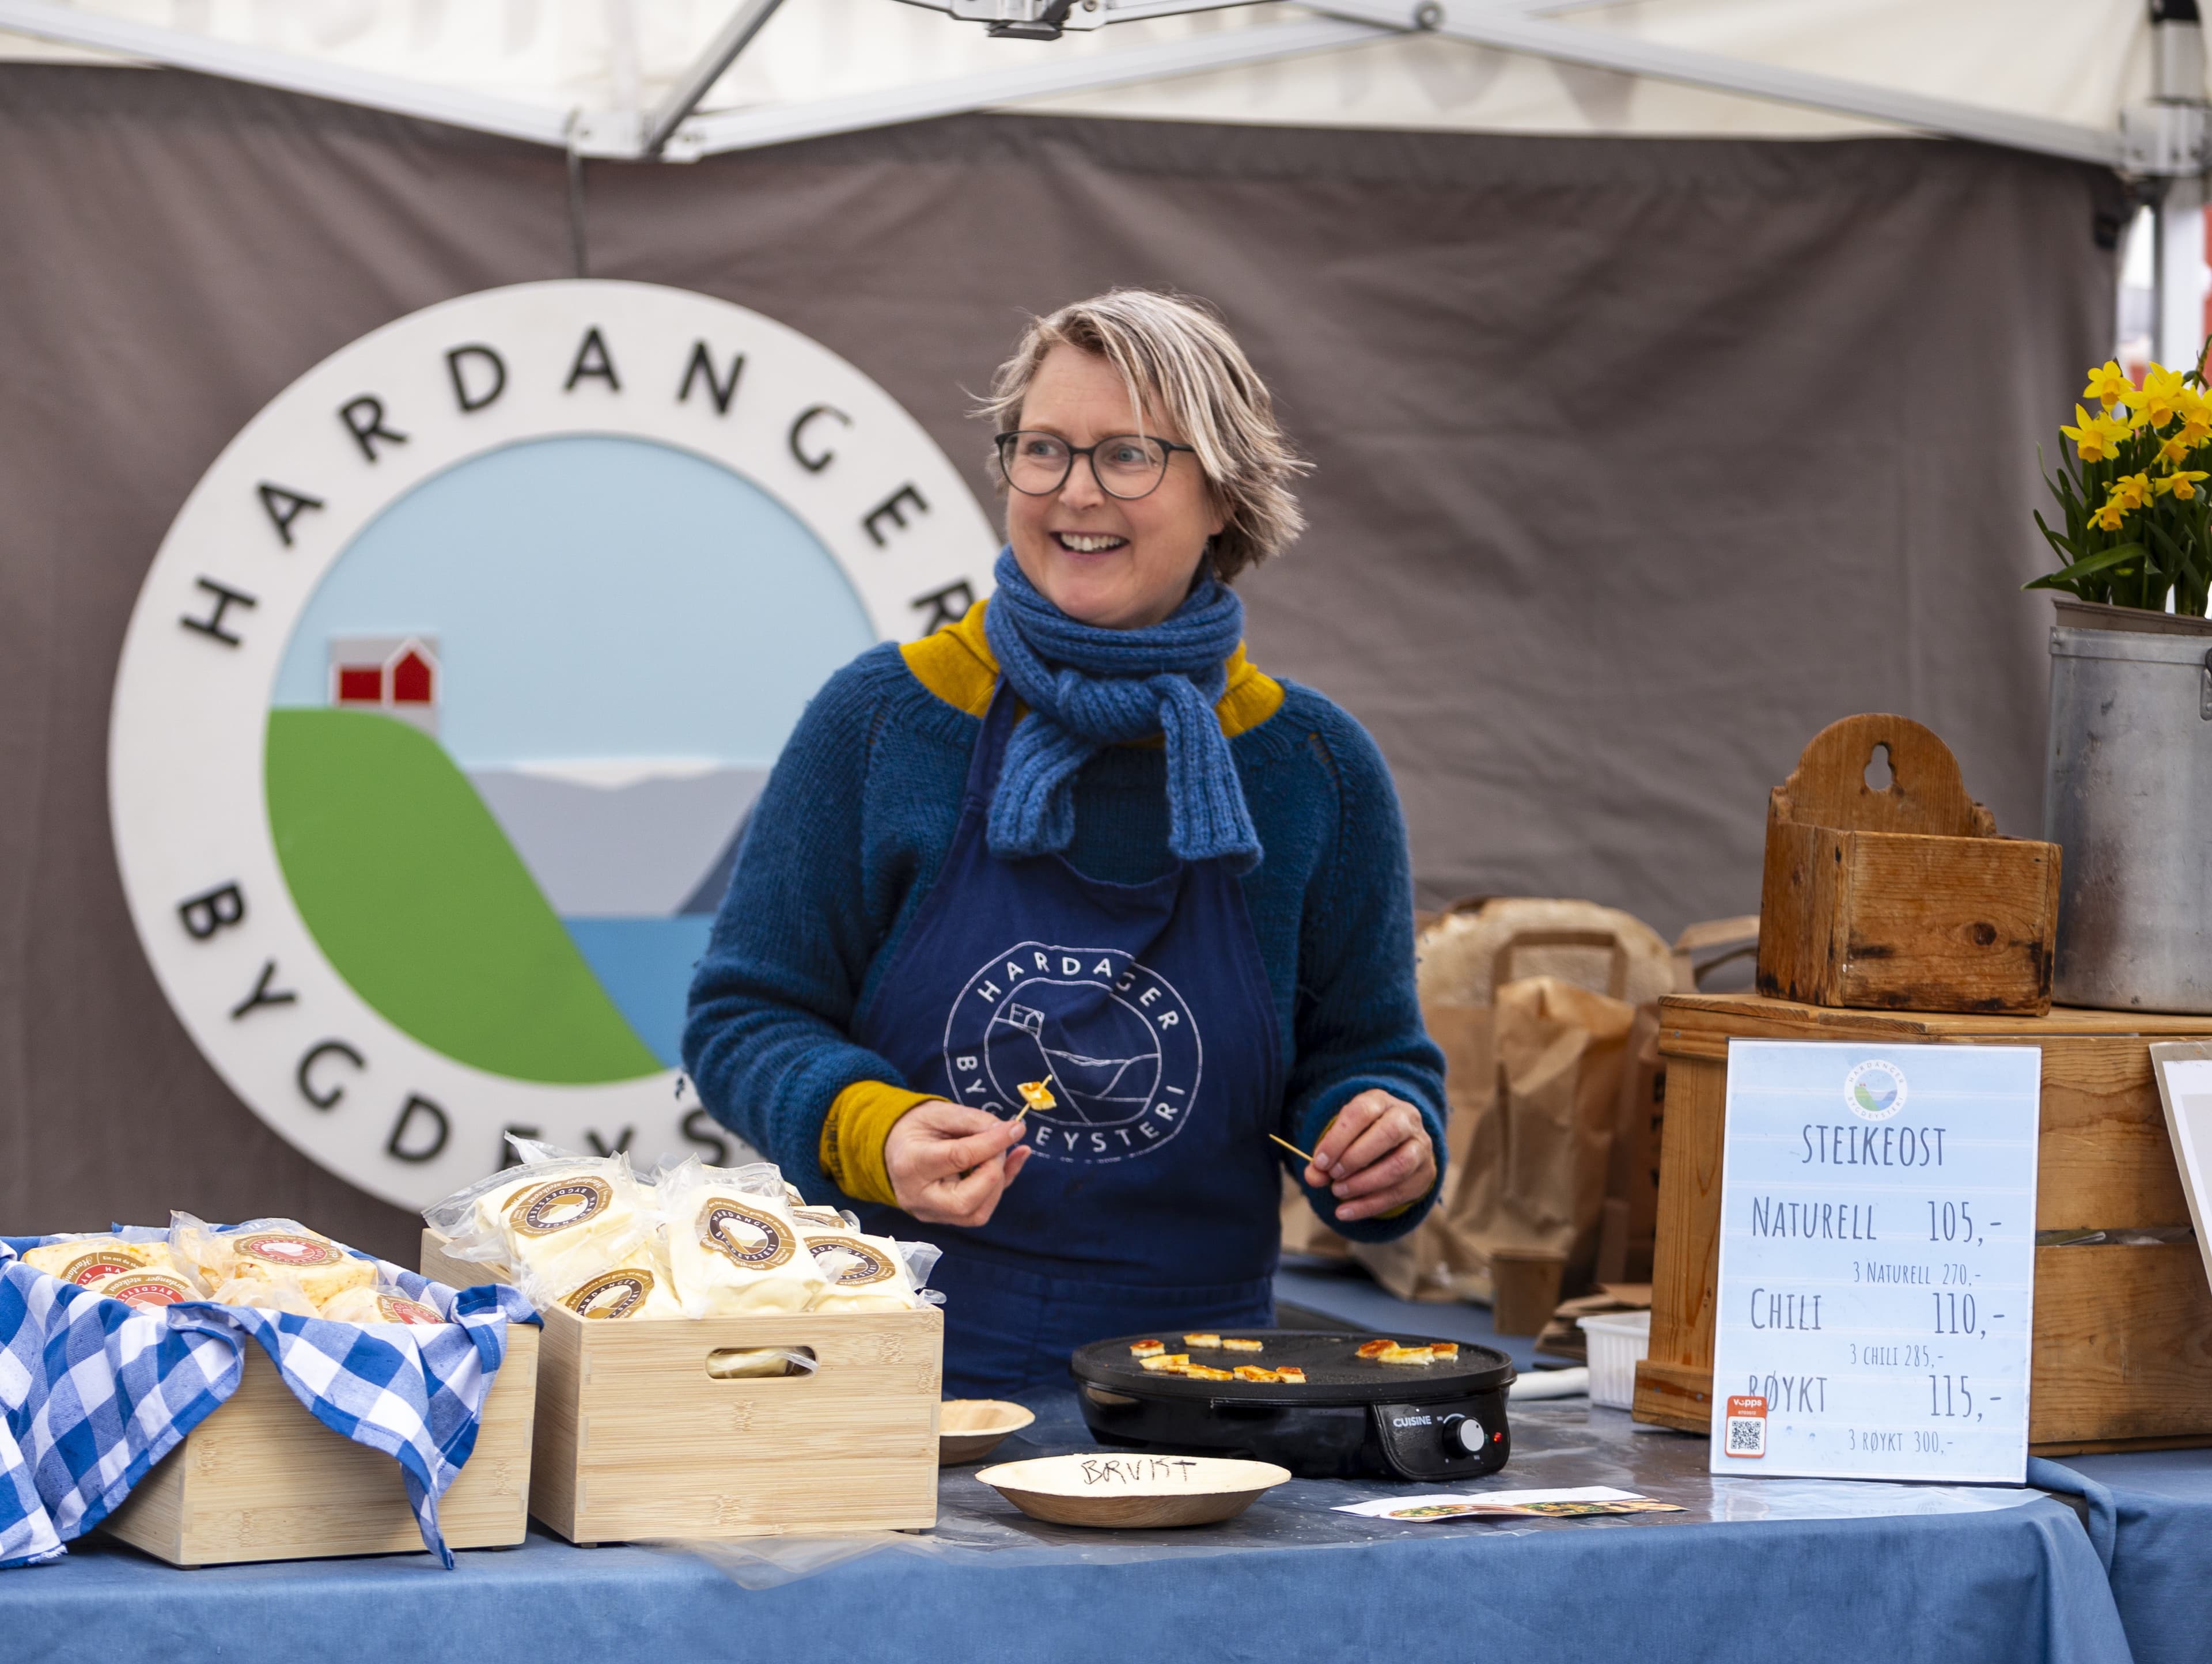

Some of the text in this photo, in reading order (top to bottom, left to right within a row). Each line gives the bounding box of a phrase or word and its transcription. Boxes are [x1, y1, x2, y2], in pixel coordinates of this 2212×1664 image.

[178, 324, 976, 648] HARDANGER
[1801, 1124, 1946, 1166] STEIKEOST
[712, 1211, 773, 1234] HARDANGER
[1752, 1196, 2002, 1246] NATURELL 105,-
[146, 1275, 188, 1291] ardanger
[1853, 1261, 1982, 1287] 3 NATURELL 270,-
[1751, 1287, 2006, 1339] CHILI 110,-
[1850, 1343, 1944, 1369] 3 CHILI 285,-
[1748, 1370, 2002, 1423] RØYKT 115,-
[1393, 1415, 1432, 1427] CUISINE
[1848, 1429, 1954, 1455] 3 RØYKT 300,-
